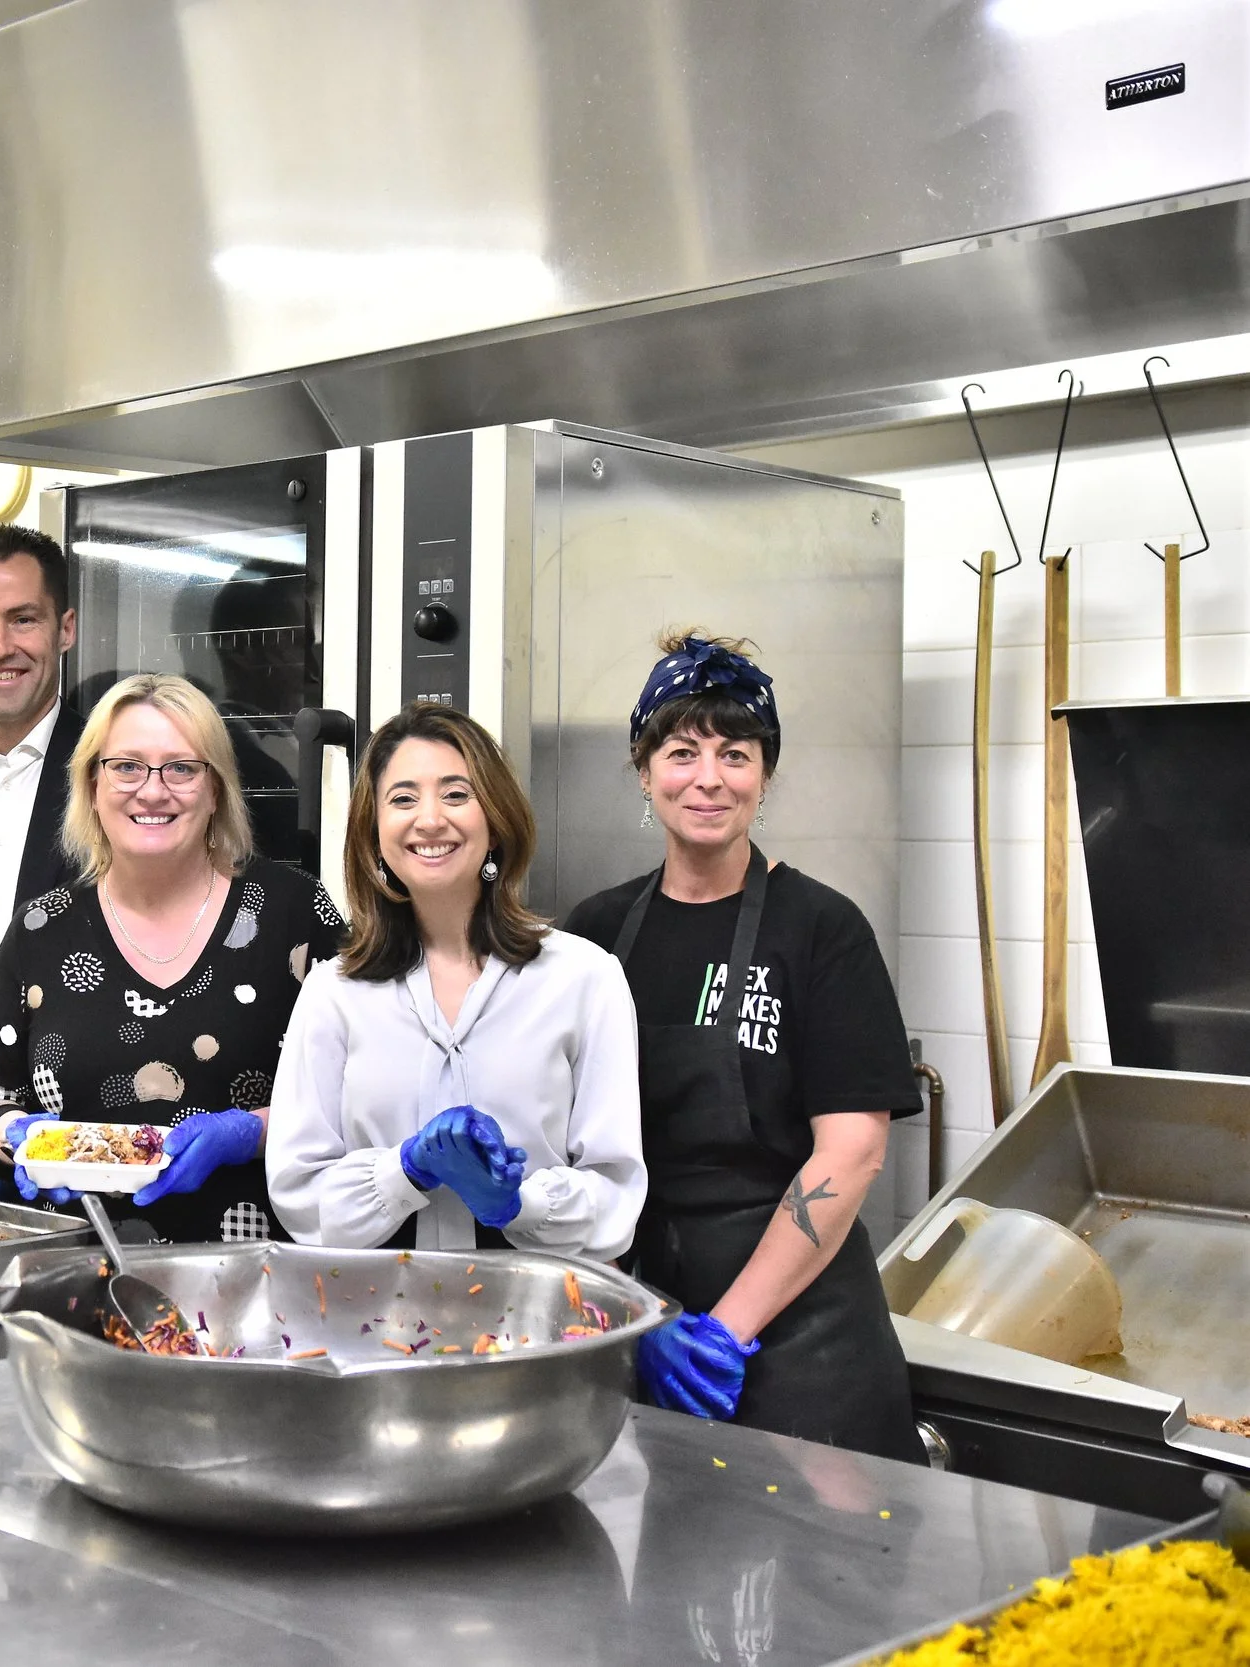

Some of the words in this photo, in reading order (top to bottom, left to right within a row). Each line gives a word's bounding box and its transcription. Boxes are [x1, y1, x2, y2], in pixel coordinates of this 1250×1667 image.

[1108, 72, 1182, 101] ATHERTON
[712, 963, 771, 993] AEX
[706, 989, 782, 1026] MKES
[703, 1016, 779, 1055] ALS
